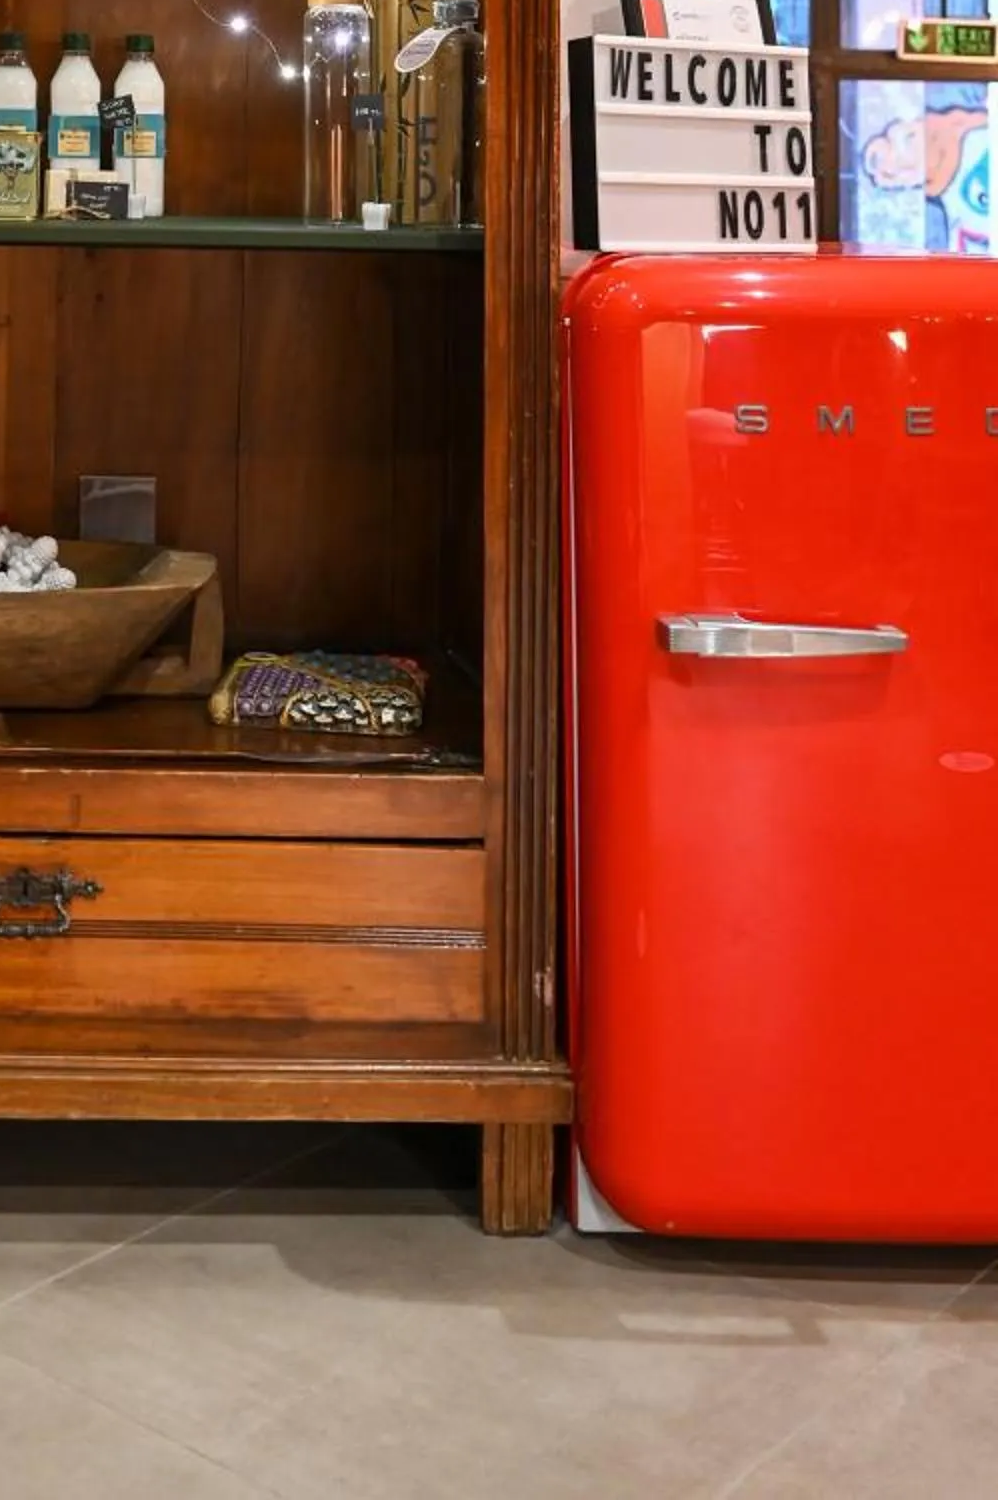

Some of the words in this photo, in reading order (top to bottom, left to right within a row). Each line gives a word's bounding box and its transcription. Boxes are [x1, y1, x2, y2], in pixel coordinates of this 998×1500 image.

[610, 48, 795, 107] WELCOME
[754, 124, 807, 176] TO
[719, 190, 812, 240] NO11
